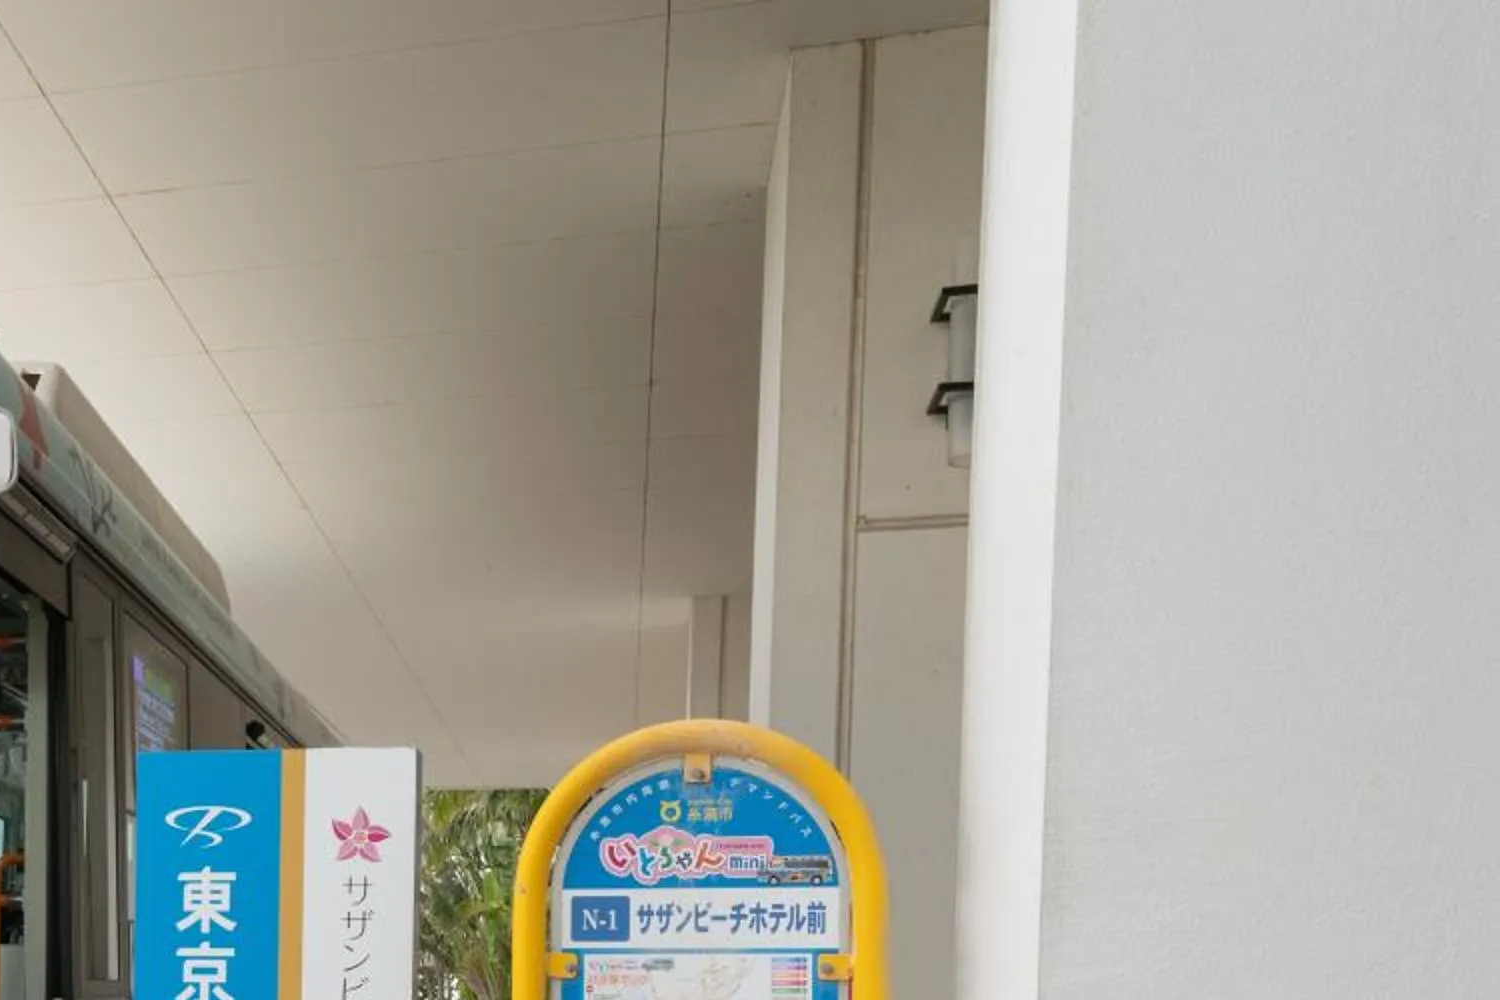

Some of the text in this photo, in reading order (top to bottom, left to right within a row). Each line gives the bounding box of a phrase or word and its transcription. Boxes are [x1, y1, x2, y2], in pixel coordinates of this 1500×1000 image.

[581, 901, 827, 935] N-1 サザンビーチホテル前
